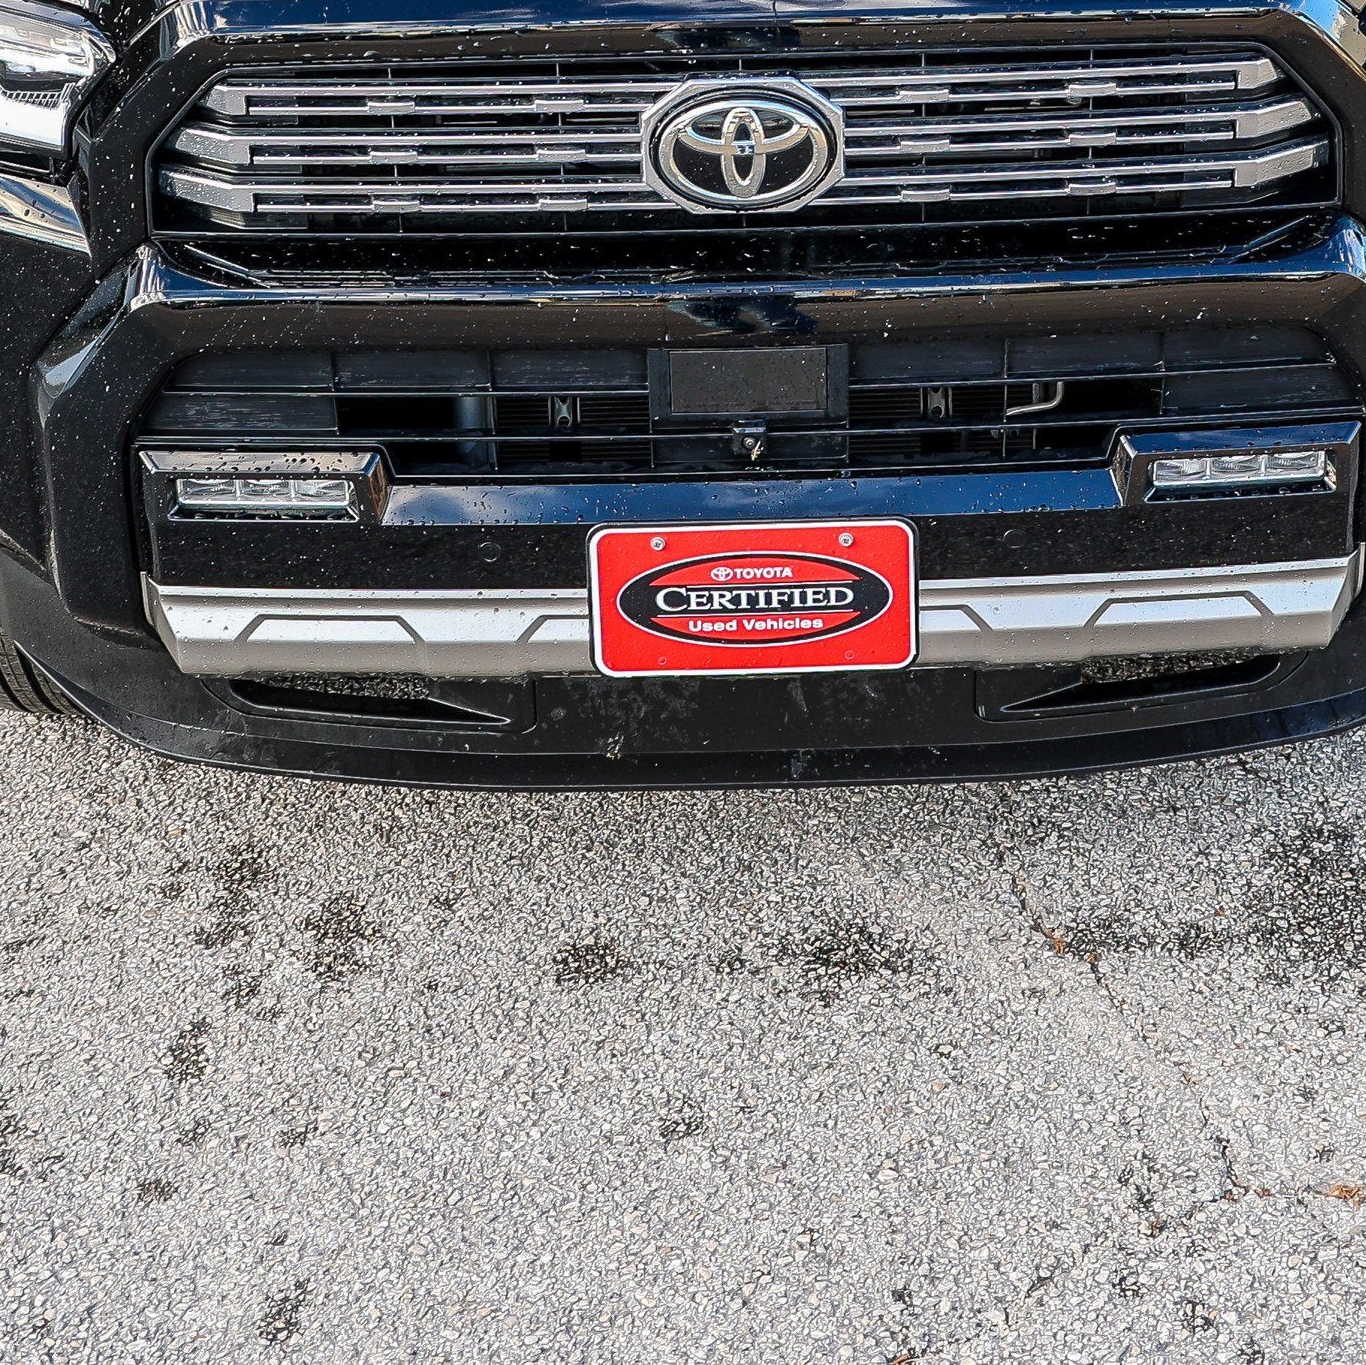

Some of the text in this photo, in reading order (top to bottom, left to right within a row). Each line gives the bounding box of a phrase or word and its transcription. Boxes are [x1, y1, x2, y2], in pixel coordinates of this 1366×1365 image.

[734, 566, 794, 580] TOYOTA
[688, 616, 824, 633] Used Vehicles
